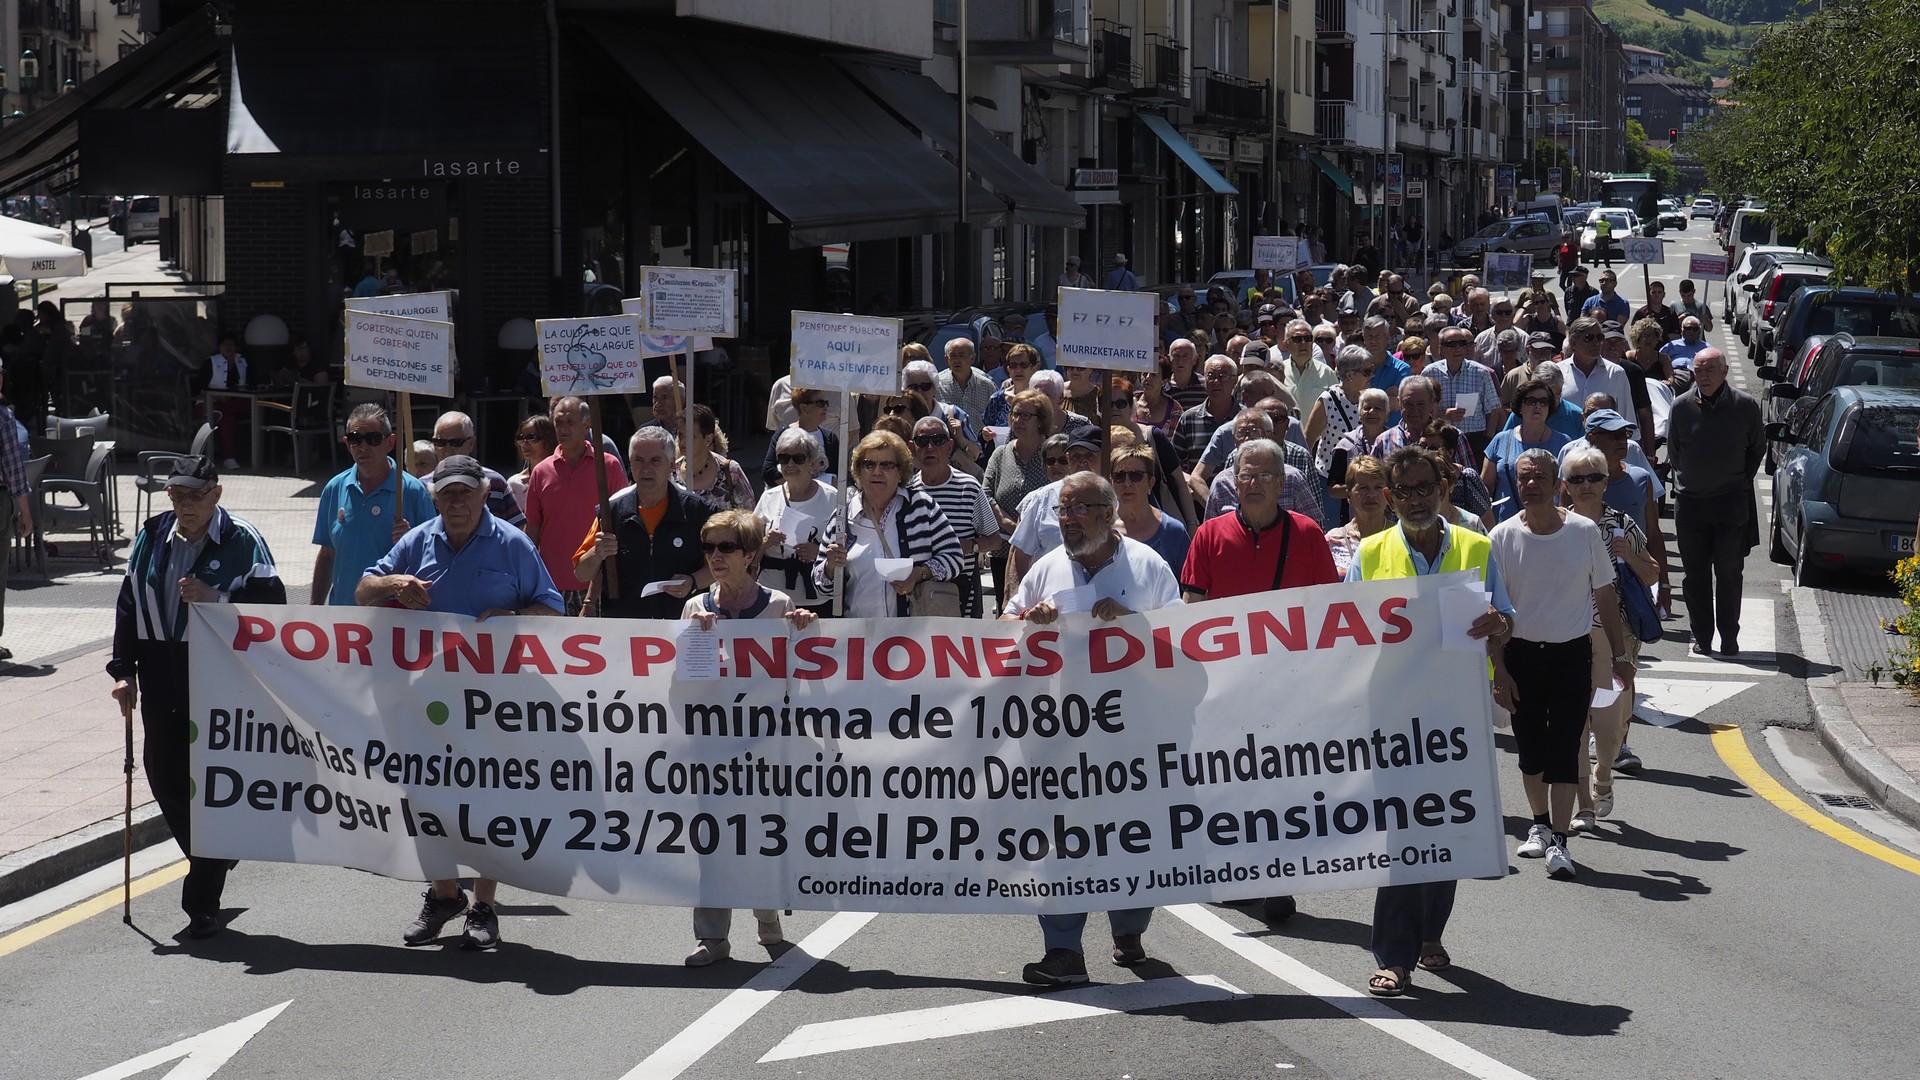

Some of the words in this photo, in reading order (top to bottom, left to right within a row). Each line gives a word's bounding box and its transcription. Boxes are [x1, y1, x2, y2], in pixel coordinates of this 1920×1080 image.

[424, 158, 521, 177] lasarte
[354, 185, 430, 199] lasarte
[31, 260, 56, 270] AMSTEL
[397, 306, 439, 316] LAUROGEI
[356, 322, 403, 336] GOBIERNE
[405, 328, 439, 340] QUIEN
[544, 330, 558, 339] LA
[560, 328, 591, 338] CULPA
[593, 326, 606, 337] DE
[608, 325, 631, 337] QUE
[799, 321, 847, 333] PENSIONES
[849, 324, 890, 337] PÚBLICAS
[373, 336, 420, 350] GOBIERNE
[543, 343, 571, 354] ESTO
[573, 342, 587, 352] SE
[589, 340, 635, 351] ALARGUE
[826, 340, 856, 353] AQUÍ
[1063, 344, 1135, 359] MURRIZKETARIK
[1136, 350, 1148, 359] EZ
[350, 353, 369, 363] LAS
[371, 356, 427, 371] PENSIONES
[430, 364, 443, 373] SE
[588, 362, 604, 370] LOS
[606, 361, 624, 370] QUE
[798, 359, 806, 368] Y
[807, 359, 836, 371] PARA
[838, 361, 889, 376] SIEMPRE!
[366, 368, 427, 383] DEFIENDEN!!!
[549, 374, 586, 384] QUEDAIS
[613, 371, 635, 379] SOFA
[232, 615, 373, 666] POR
[392, 627, 607, 677] UNAS
[631, 631, 1064, 681] PNSIONES
[1089, 597, 1413, 674] DIGNAS
[464, 689, 667, 735] Pensión
[685, 693, 873, 740] mínima
[888, 694, 953, 740] de
[970, 689, 1125, 739] 1.080€
[208, 708, 319, 760] Blindar
[316, 731, 356, 776] las
[364, 740, 541, 790] Pensiones
[550, 760, 593, 792] en
[604, 747, 634, 793] la
[644, 750, 872, 798] Constitución
[882, 765, 976, 801] como
[984, 752, 1148, 800] Derechos
[1157, 717, 1468, 789] Fundamentales
[204, 766, 392, 833] Derogar
[401, 797, 448, 838] la
[459, 803, 552, 861] Ley
[565, 808, 788, 857] 23/2013
[805, 812, 888, 860] del
[906, 815, 984, 862] P.P.
[997, 813, 1152, 862] sobre
[1169, 788, 1477, 850] Pensiones
[798, 876, 944, 898] Coordinadora
[954, 877, 981, 898] de
[987, 874, 1120, 899] Pensionistas
[1126, 876, 1140, 897] y
[1146, 860, 1260, 891] Jubilados
[1266, 857, 1296, 879] de
[1303, 844, 1452, 877] Lasarte-Oria
